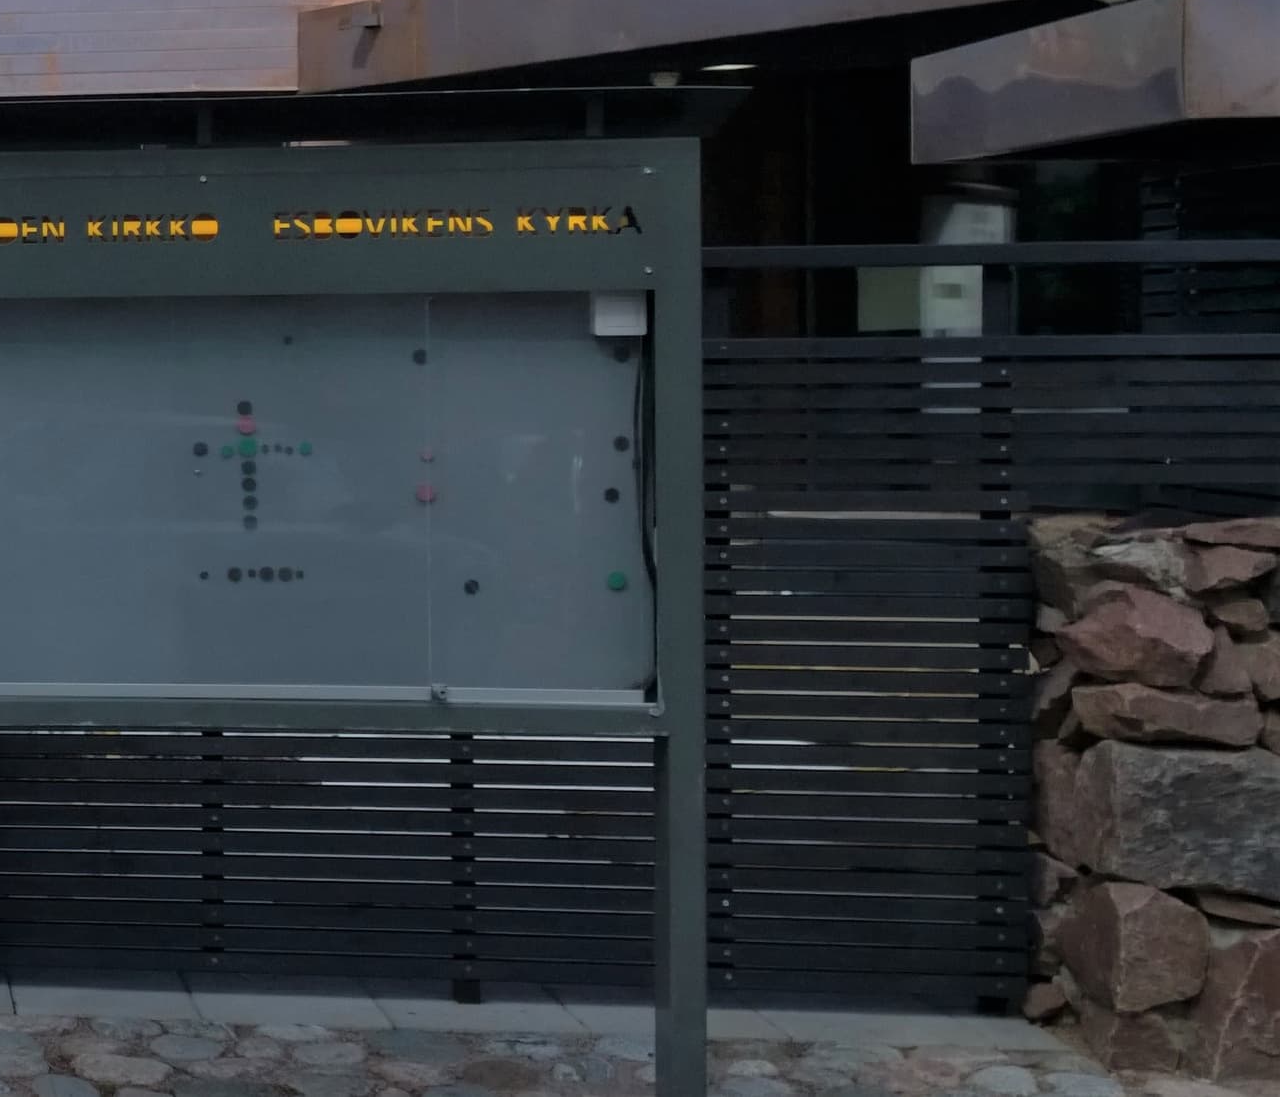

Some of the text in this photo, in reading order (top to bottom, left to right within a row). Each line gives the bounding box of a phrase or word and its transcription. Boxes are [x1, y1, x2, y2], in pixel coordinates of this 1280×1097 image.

[86, 212, 219, 244] KIRKKO
[272, 208, 495, 240] ESBOVIKENS
[515, 205, 643, 237] KYRKA
